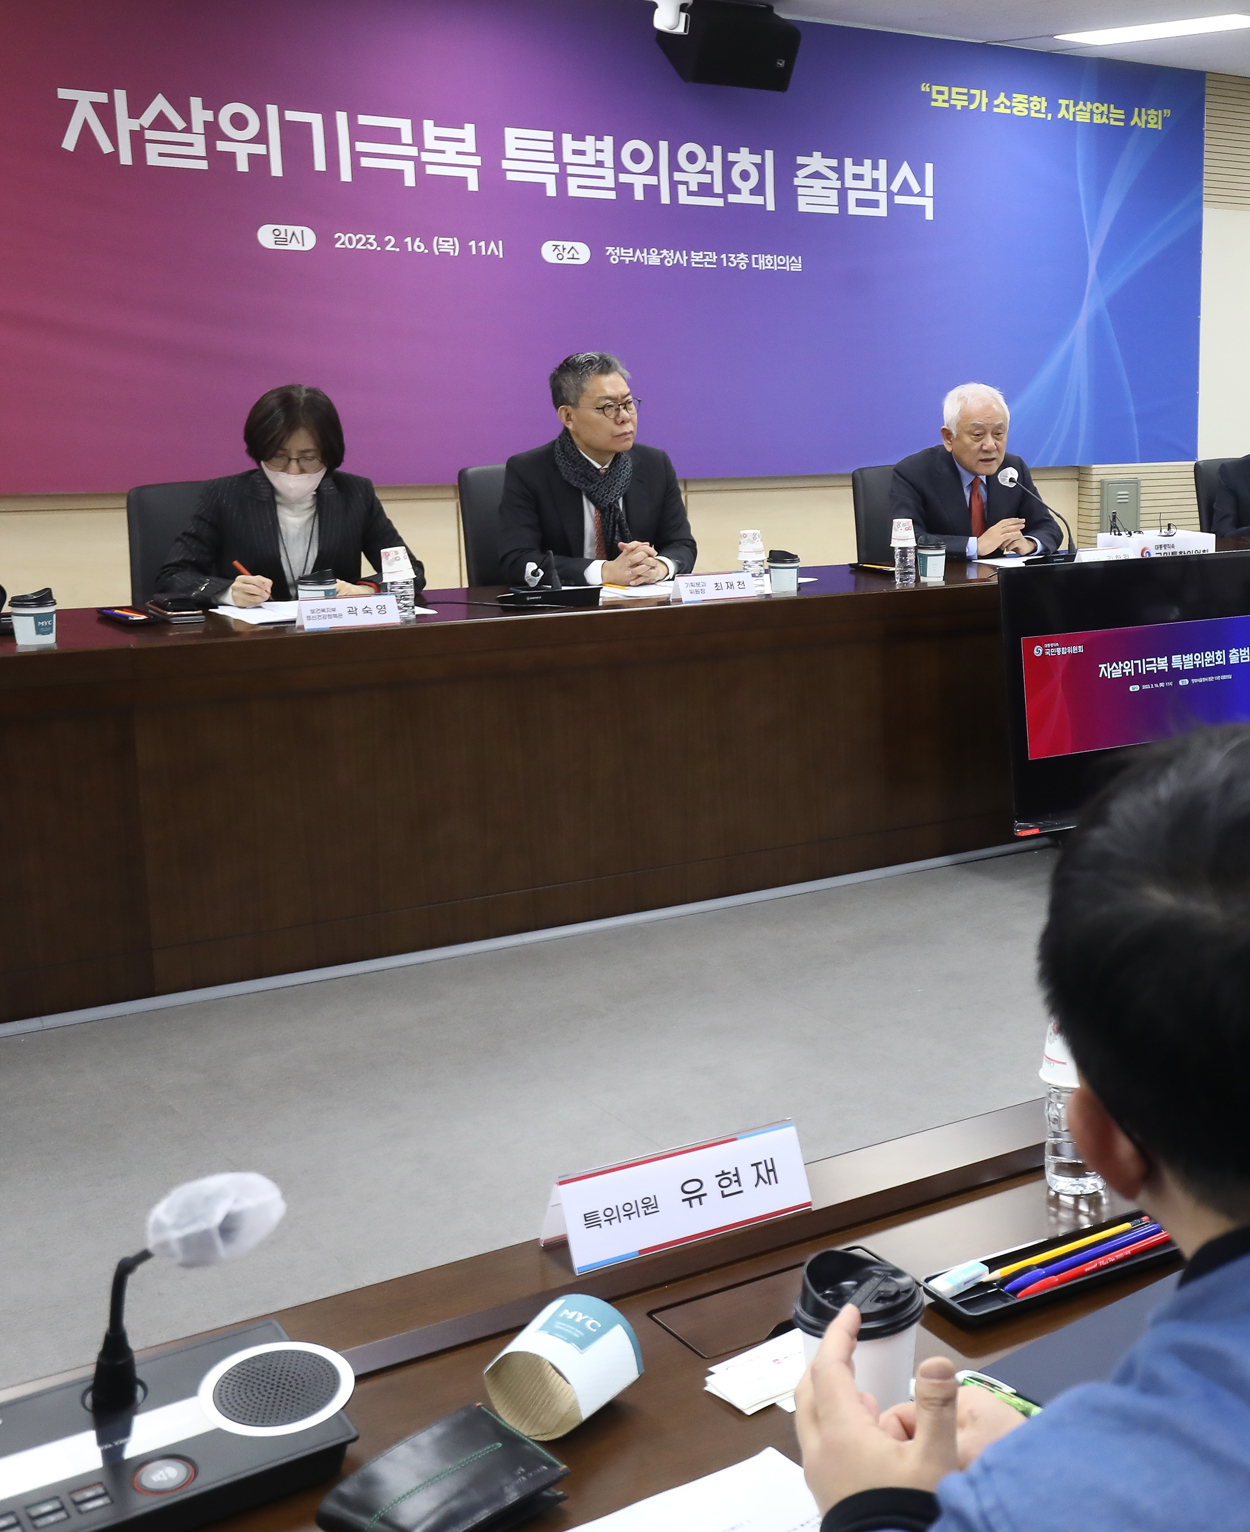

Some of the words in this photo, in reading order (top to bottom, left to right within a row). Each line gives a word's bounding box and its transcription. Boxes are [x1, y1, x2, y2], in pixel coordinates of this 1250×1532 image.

[993, 92, 1052, 121] 소중한,
[1057, 98, 1125, 127] 자살없는
[57, 87, 483, 192] 자살위기극복
[501, 127, 776, 211] 특별위원회
[793, 151, 935, 221] 출범식
[271, 228, 306, 247] 일시
[334, 232, 381, 251] 2023.
[384, 235, 400, 252] 2.
[404, 236, 429, 254] 16.
[433, 236, 460, 257] (목)
[468, 240, 504, 259] 11시
[551, 244, 580, 261] 장소
[605, 246, 688, 267] 정부서울청사
[690, 251, 718, 268] 본관
[720, 253, 750, 270] 13층
[751, 254, 803, 272] 대회의실
[714, 580, 746, 590] 최재천
[347, 604, 387, 616] 곽숙영
[1098, 655, 1169, 679] 자살위기극복
[1171, 649, 1226, 671] 특별위원회
[583, 1194, 661, 1230] 특위위원
[680, 1157, 779, 1209] 유현재
